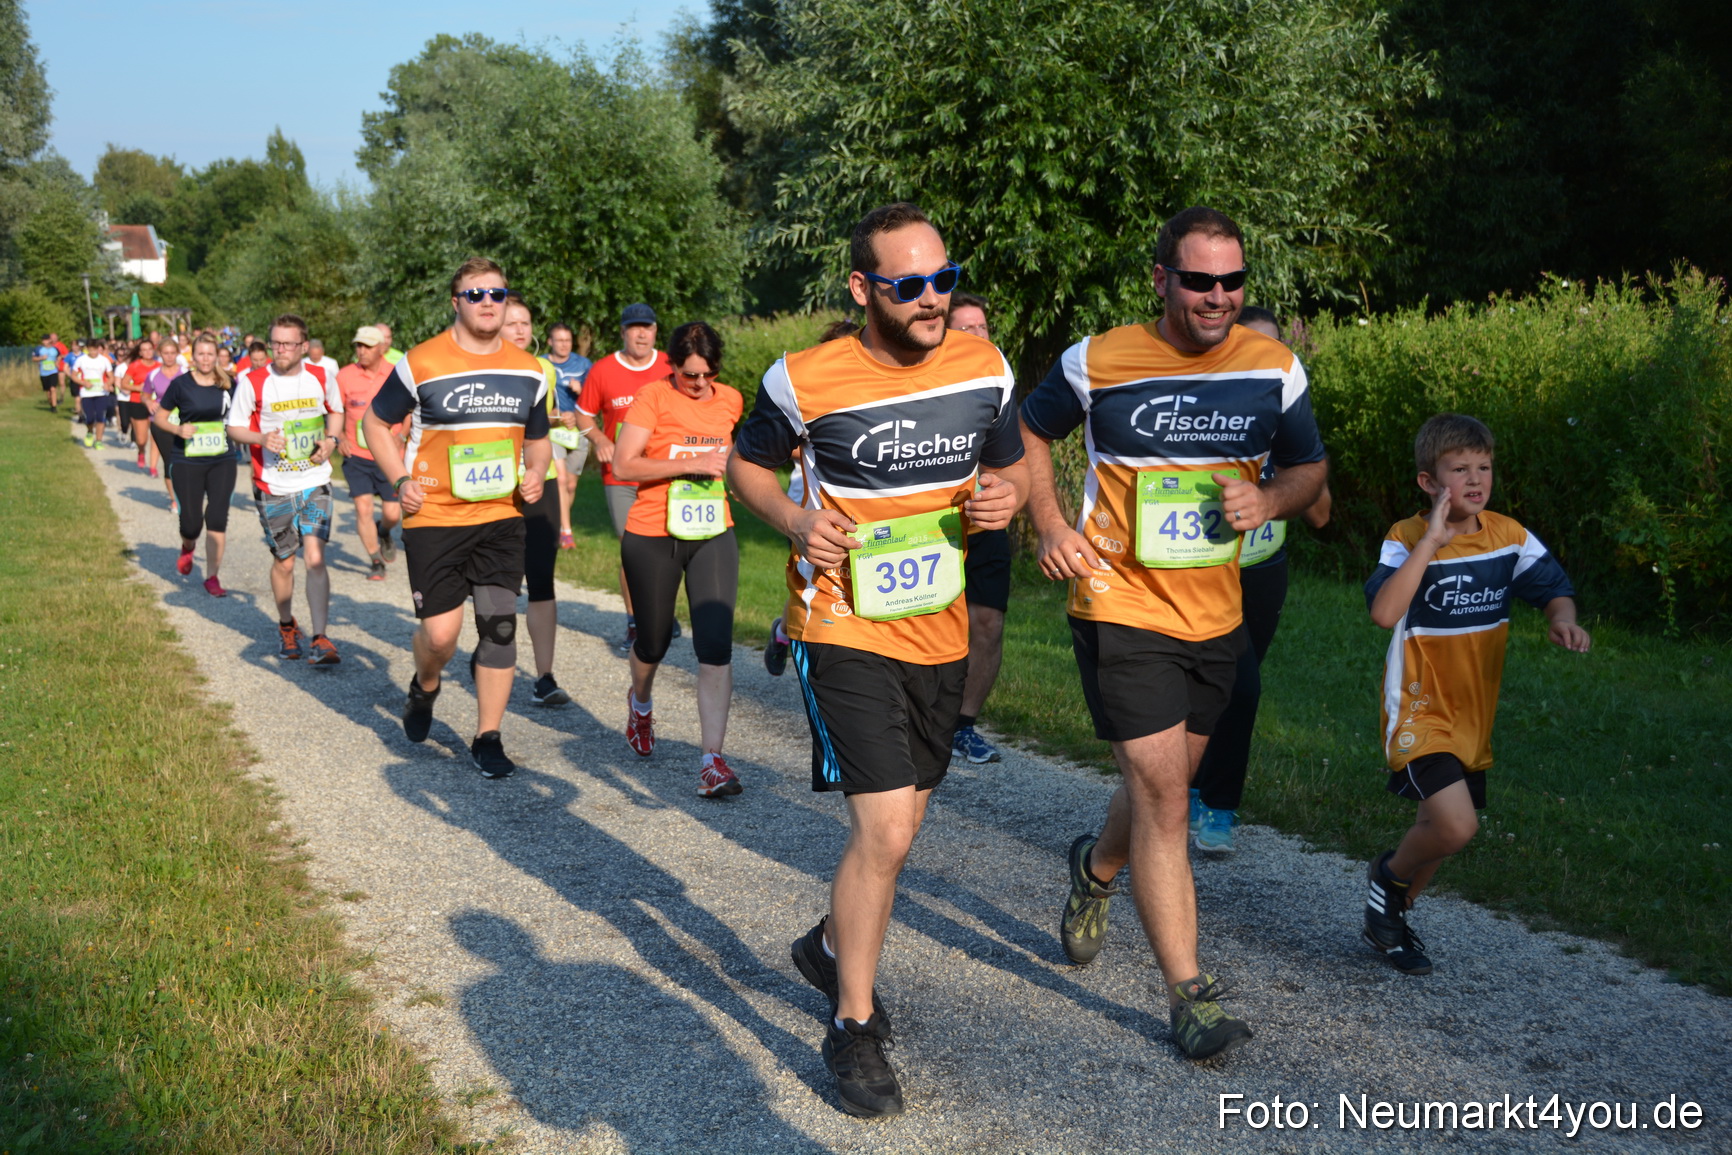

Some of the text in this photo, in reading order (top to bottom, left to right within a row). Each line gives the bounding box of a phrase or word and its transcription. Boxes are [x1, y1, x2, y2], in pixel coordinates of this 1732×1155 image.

[273, 399, 317, 411] ONLINE
[458, 392, 522, 408] Fischer
[465, 406, 519, 415] AUTOMOBILE
[1154, 410, 1256, 431] Fischer
[684, 436, 724, 445] 30 Jahre
[877, 432, 977, 462] Fischer
[1164, 433, 1247, 442] AUTOMOBILE
[888, 452, 972, 472] AUTOMOBILE
[465, 464, 504, 485] 444
[681, 504, 716, 523] 618
[1158, 510, 1222, 541] 432
[866, 534, 907, 548] firmenlauf
[875, 553, 941, 594] 397
[885, 593, 938, 607] Andreas Köllner
[1442, 586, 1507, 607] Fischer
